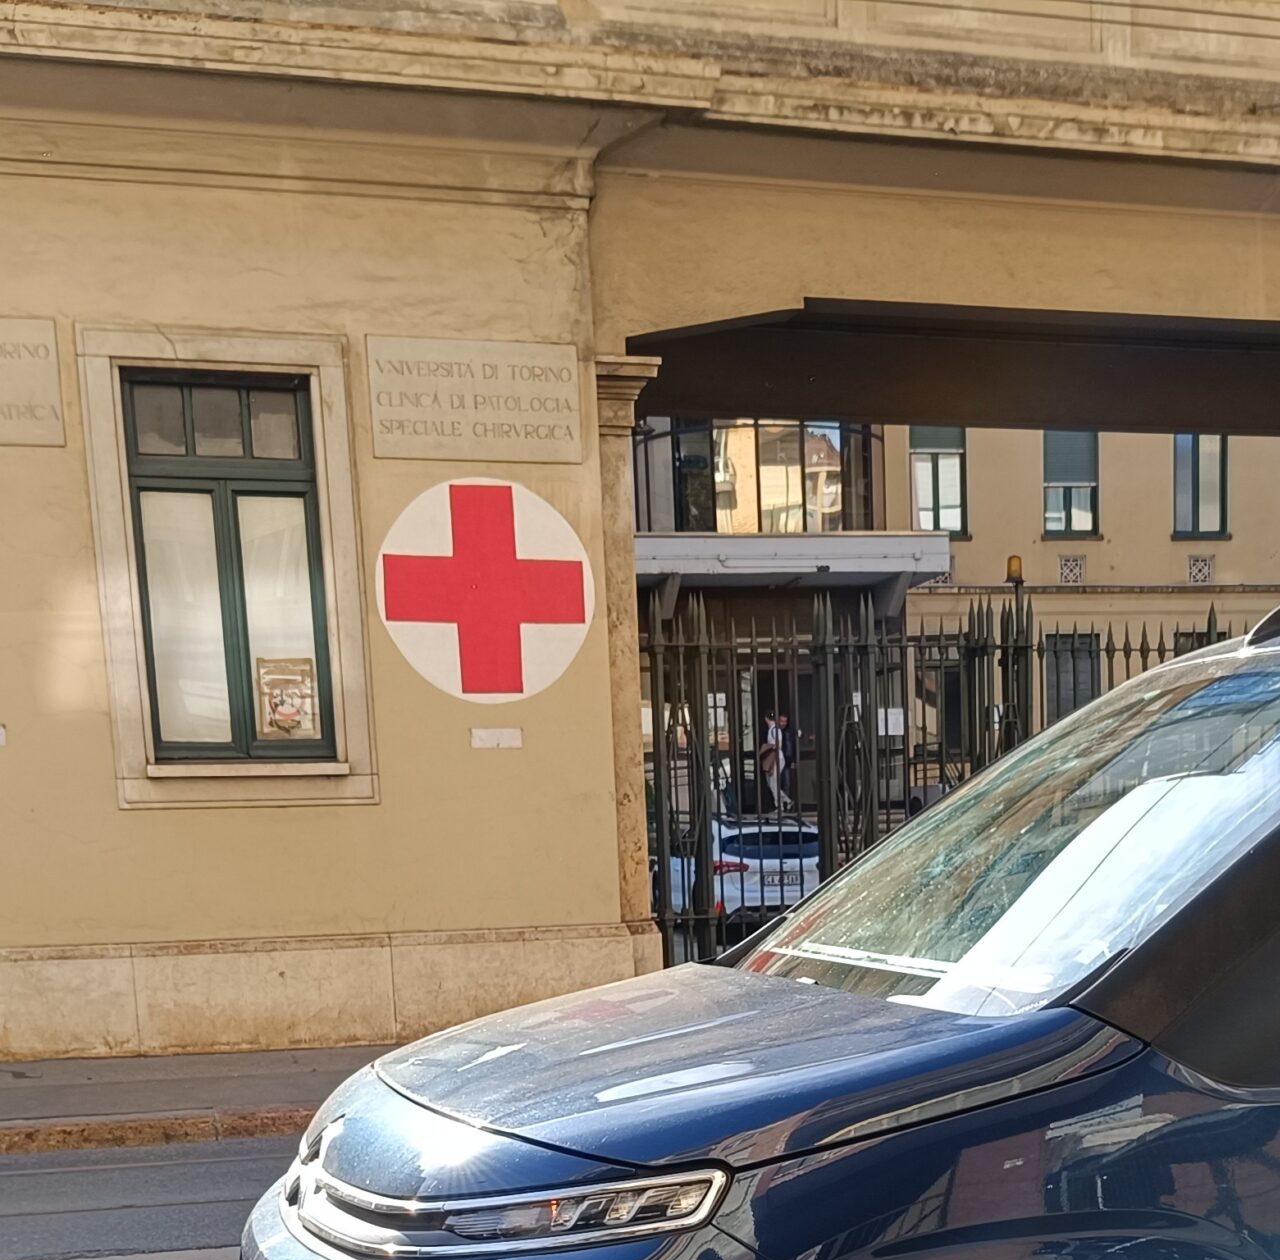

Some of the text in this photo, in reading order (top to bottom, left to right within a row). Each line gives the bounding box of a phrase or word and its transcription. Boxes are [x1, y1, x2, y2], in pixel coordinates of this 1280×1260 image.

[0, 342, 50, 360] RINO
[483, 363, 499, 380] DI
[508, 364, 573, 383] TORINO
[376, 389, 574, 413] CLINICA DI PATOLOGIA
[379, 418, 463, 438] SPECIALE
